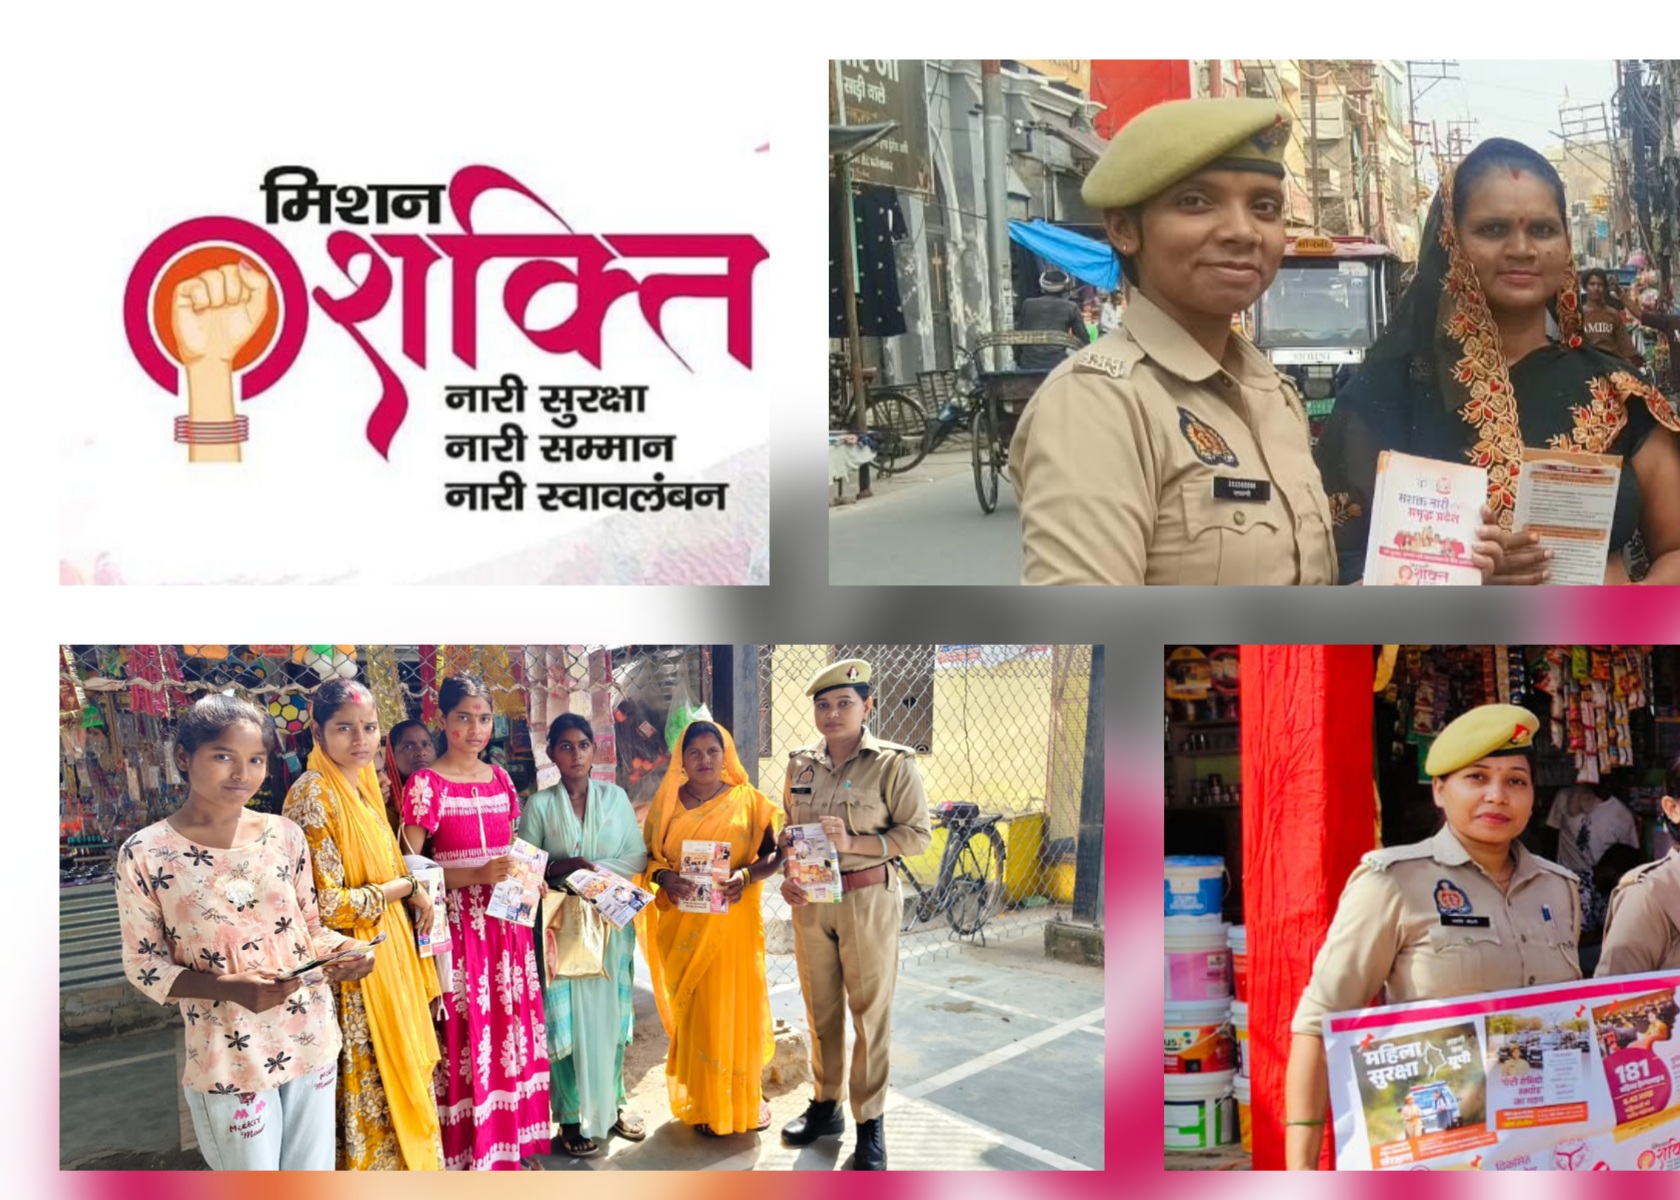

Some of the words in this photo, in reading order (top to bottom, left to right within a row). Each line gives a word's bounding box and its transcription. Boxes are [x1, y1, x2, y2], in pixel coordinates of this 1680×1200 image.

[1363, 1039, 1424, 1068] महिला
[1366, 1060, 1420, 1090] सुरक्षा
[1615, 1059, 1650, 1084] 181
